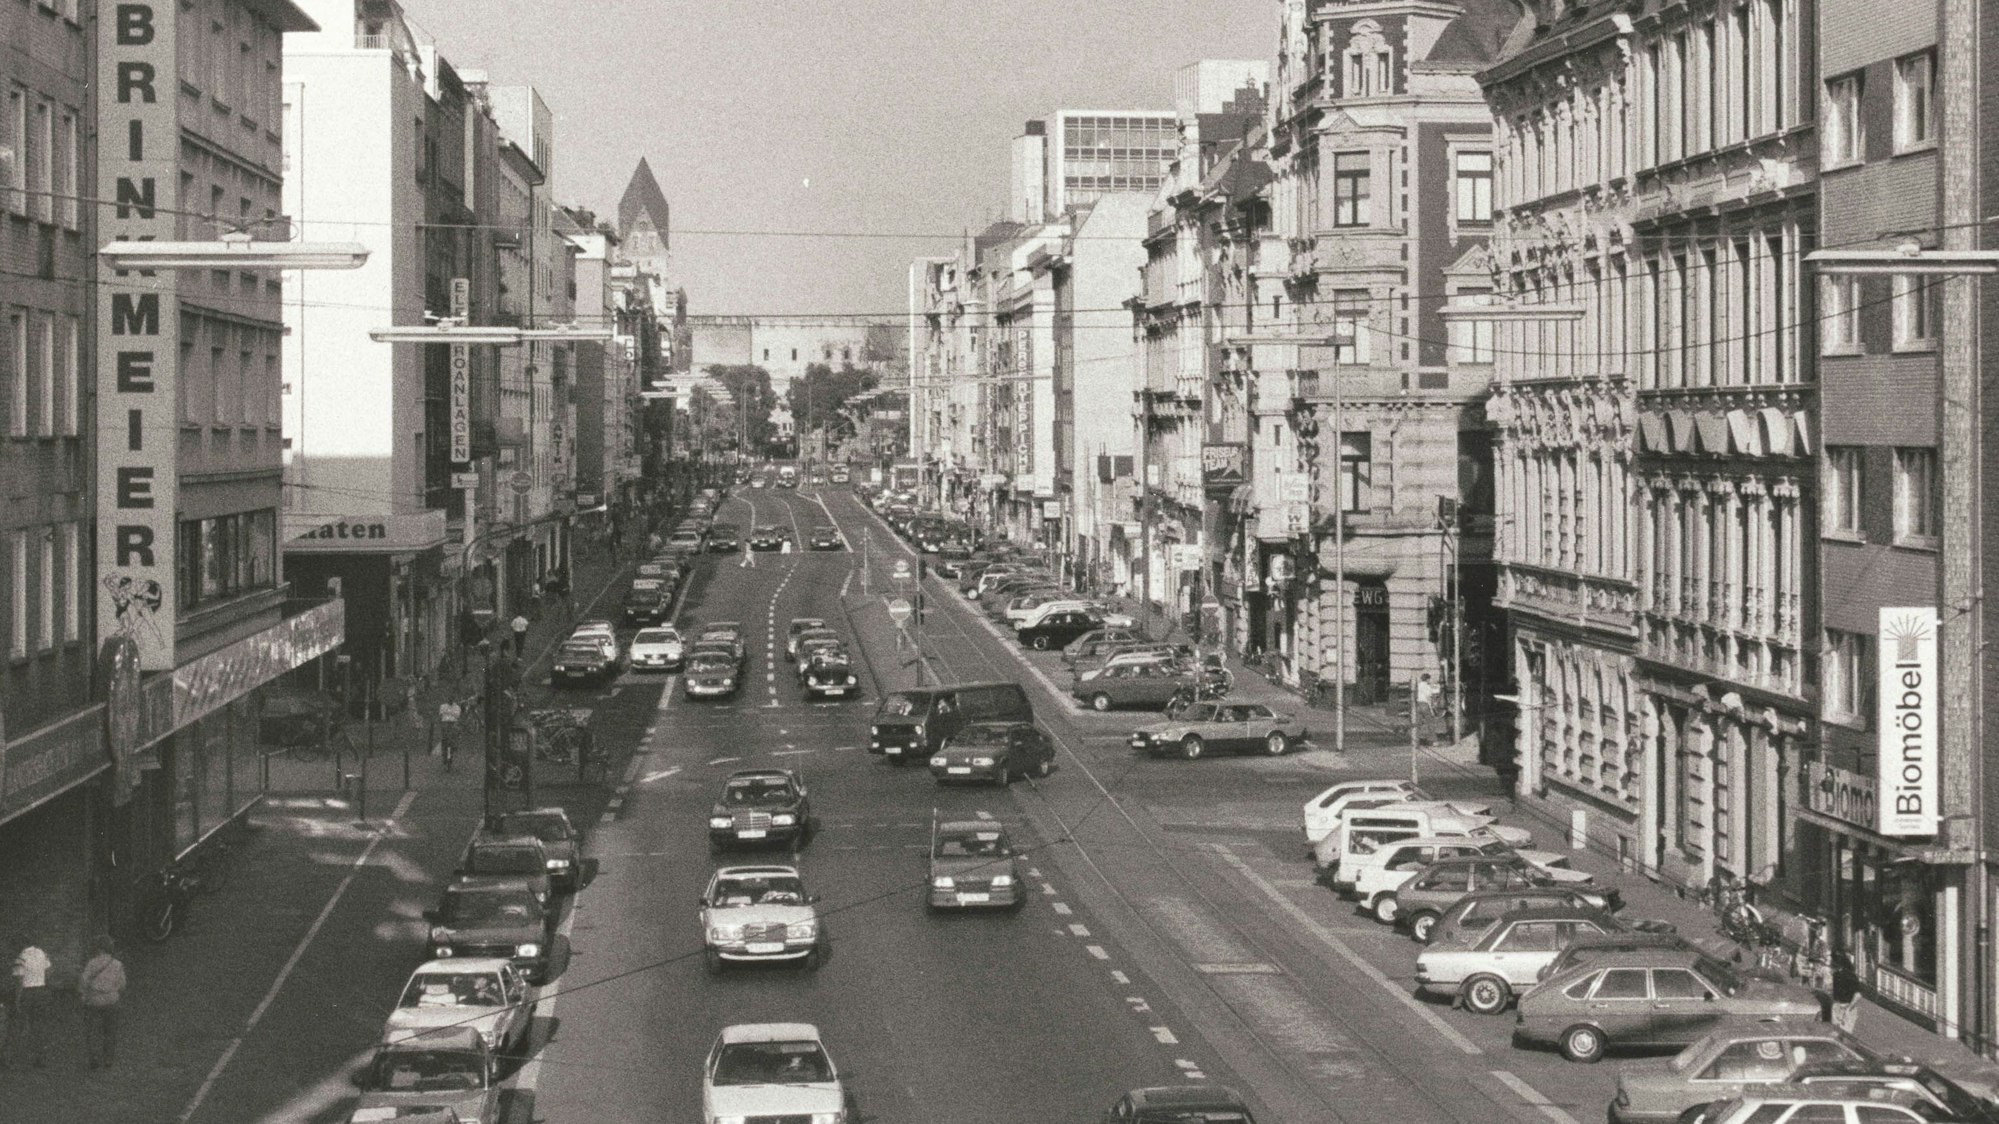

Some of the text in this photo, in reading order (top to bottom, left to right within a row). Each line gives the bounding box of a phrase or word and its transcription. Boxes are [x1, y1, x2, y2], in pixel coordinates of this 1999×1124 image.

[453, 281, 467, 459] ELEKROANLAGEN
[299, 521, 387, 540] aten
[1895, 662, 1922, 816] Biomöbel
